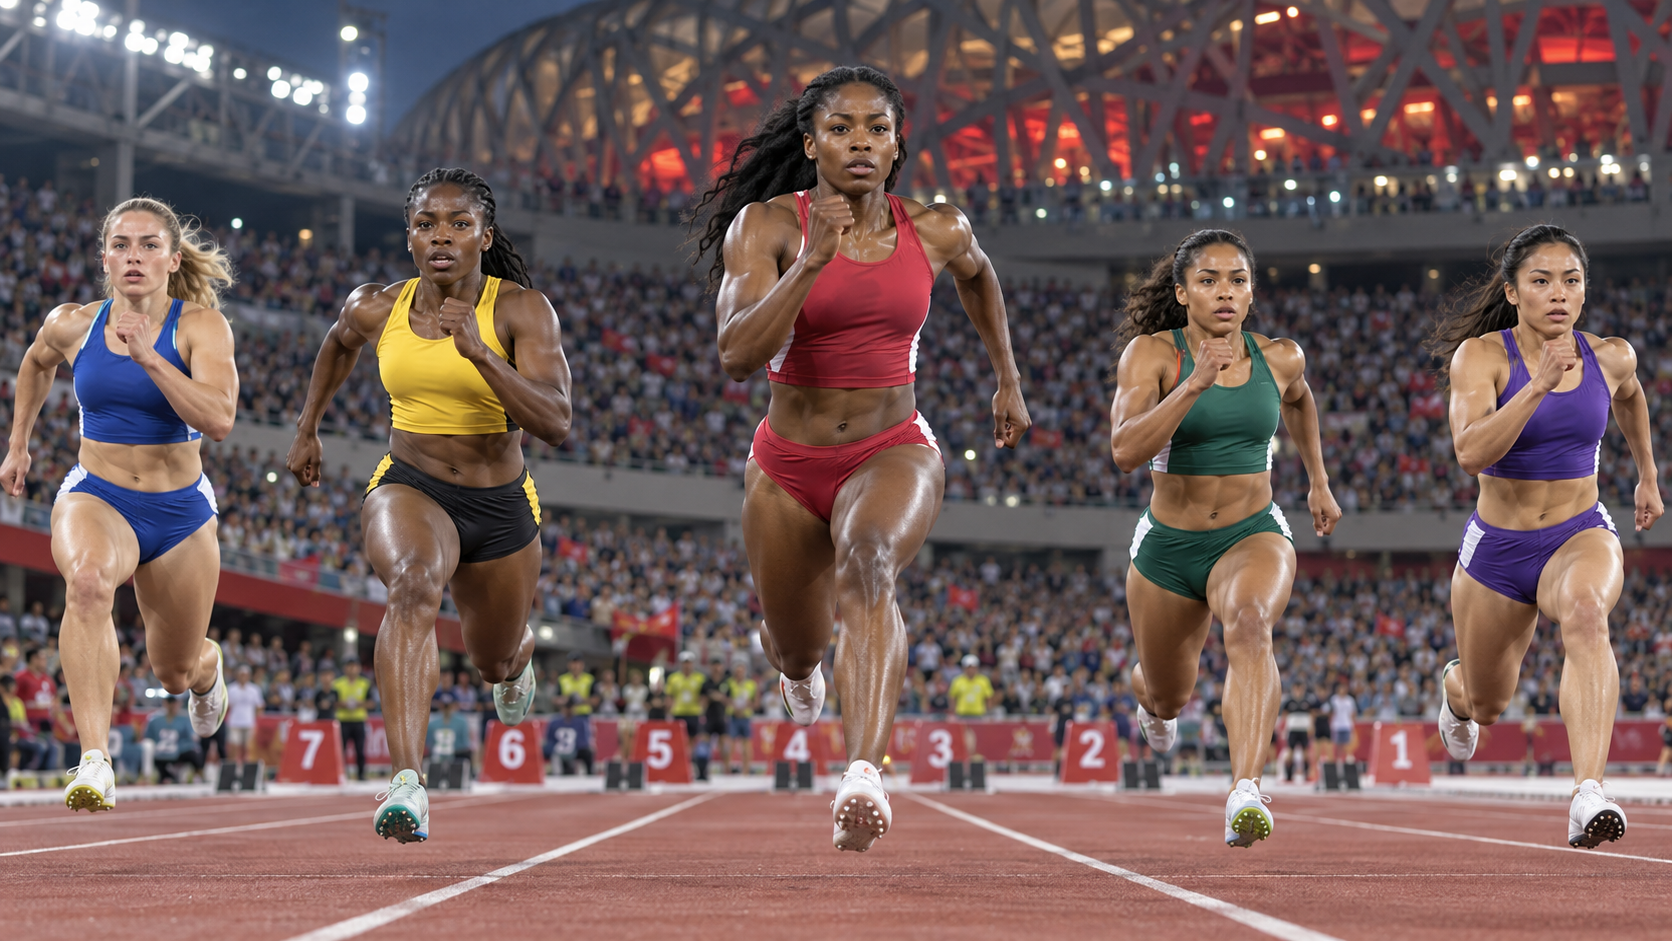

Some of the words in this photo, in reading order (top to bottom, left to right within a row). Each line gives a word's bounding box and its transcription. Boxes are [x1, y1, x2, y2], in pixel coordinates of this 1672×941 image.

[299, 730, 324, 769] 7
[499, 729, 525, 769] 6
[647, 730, 672, 769] 5
[783, 729, 811, 763] 4
[928, 729, 953, 768] 3
[1079, 729, 1105, 768] 2
[1389, 729, 1413, 770] 1
